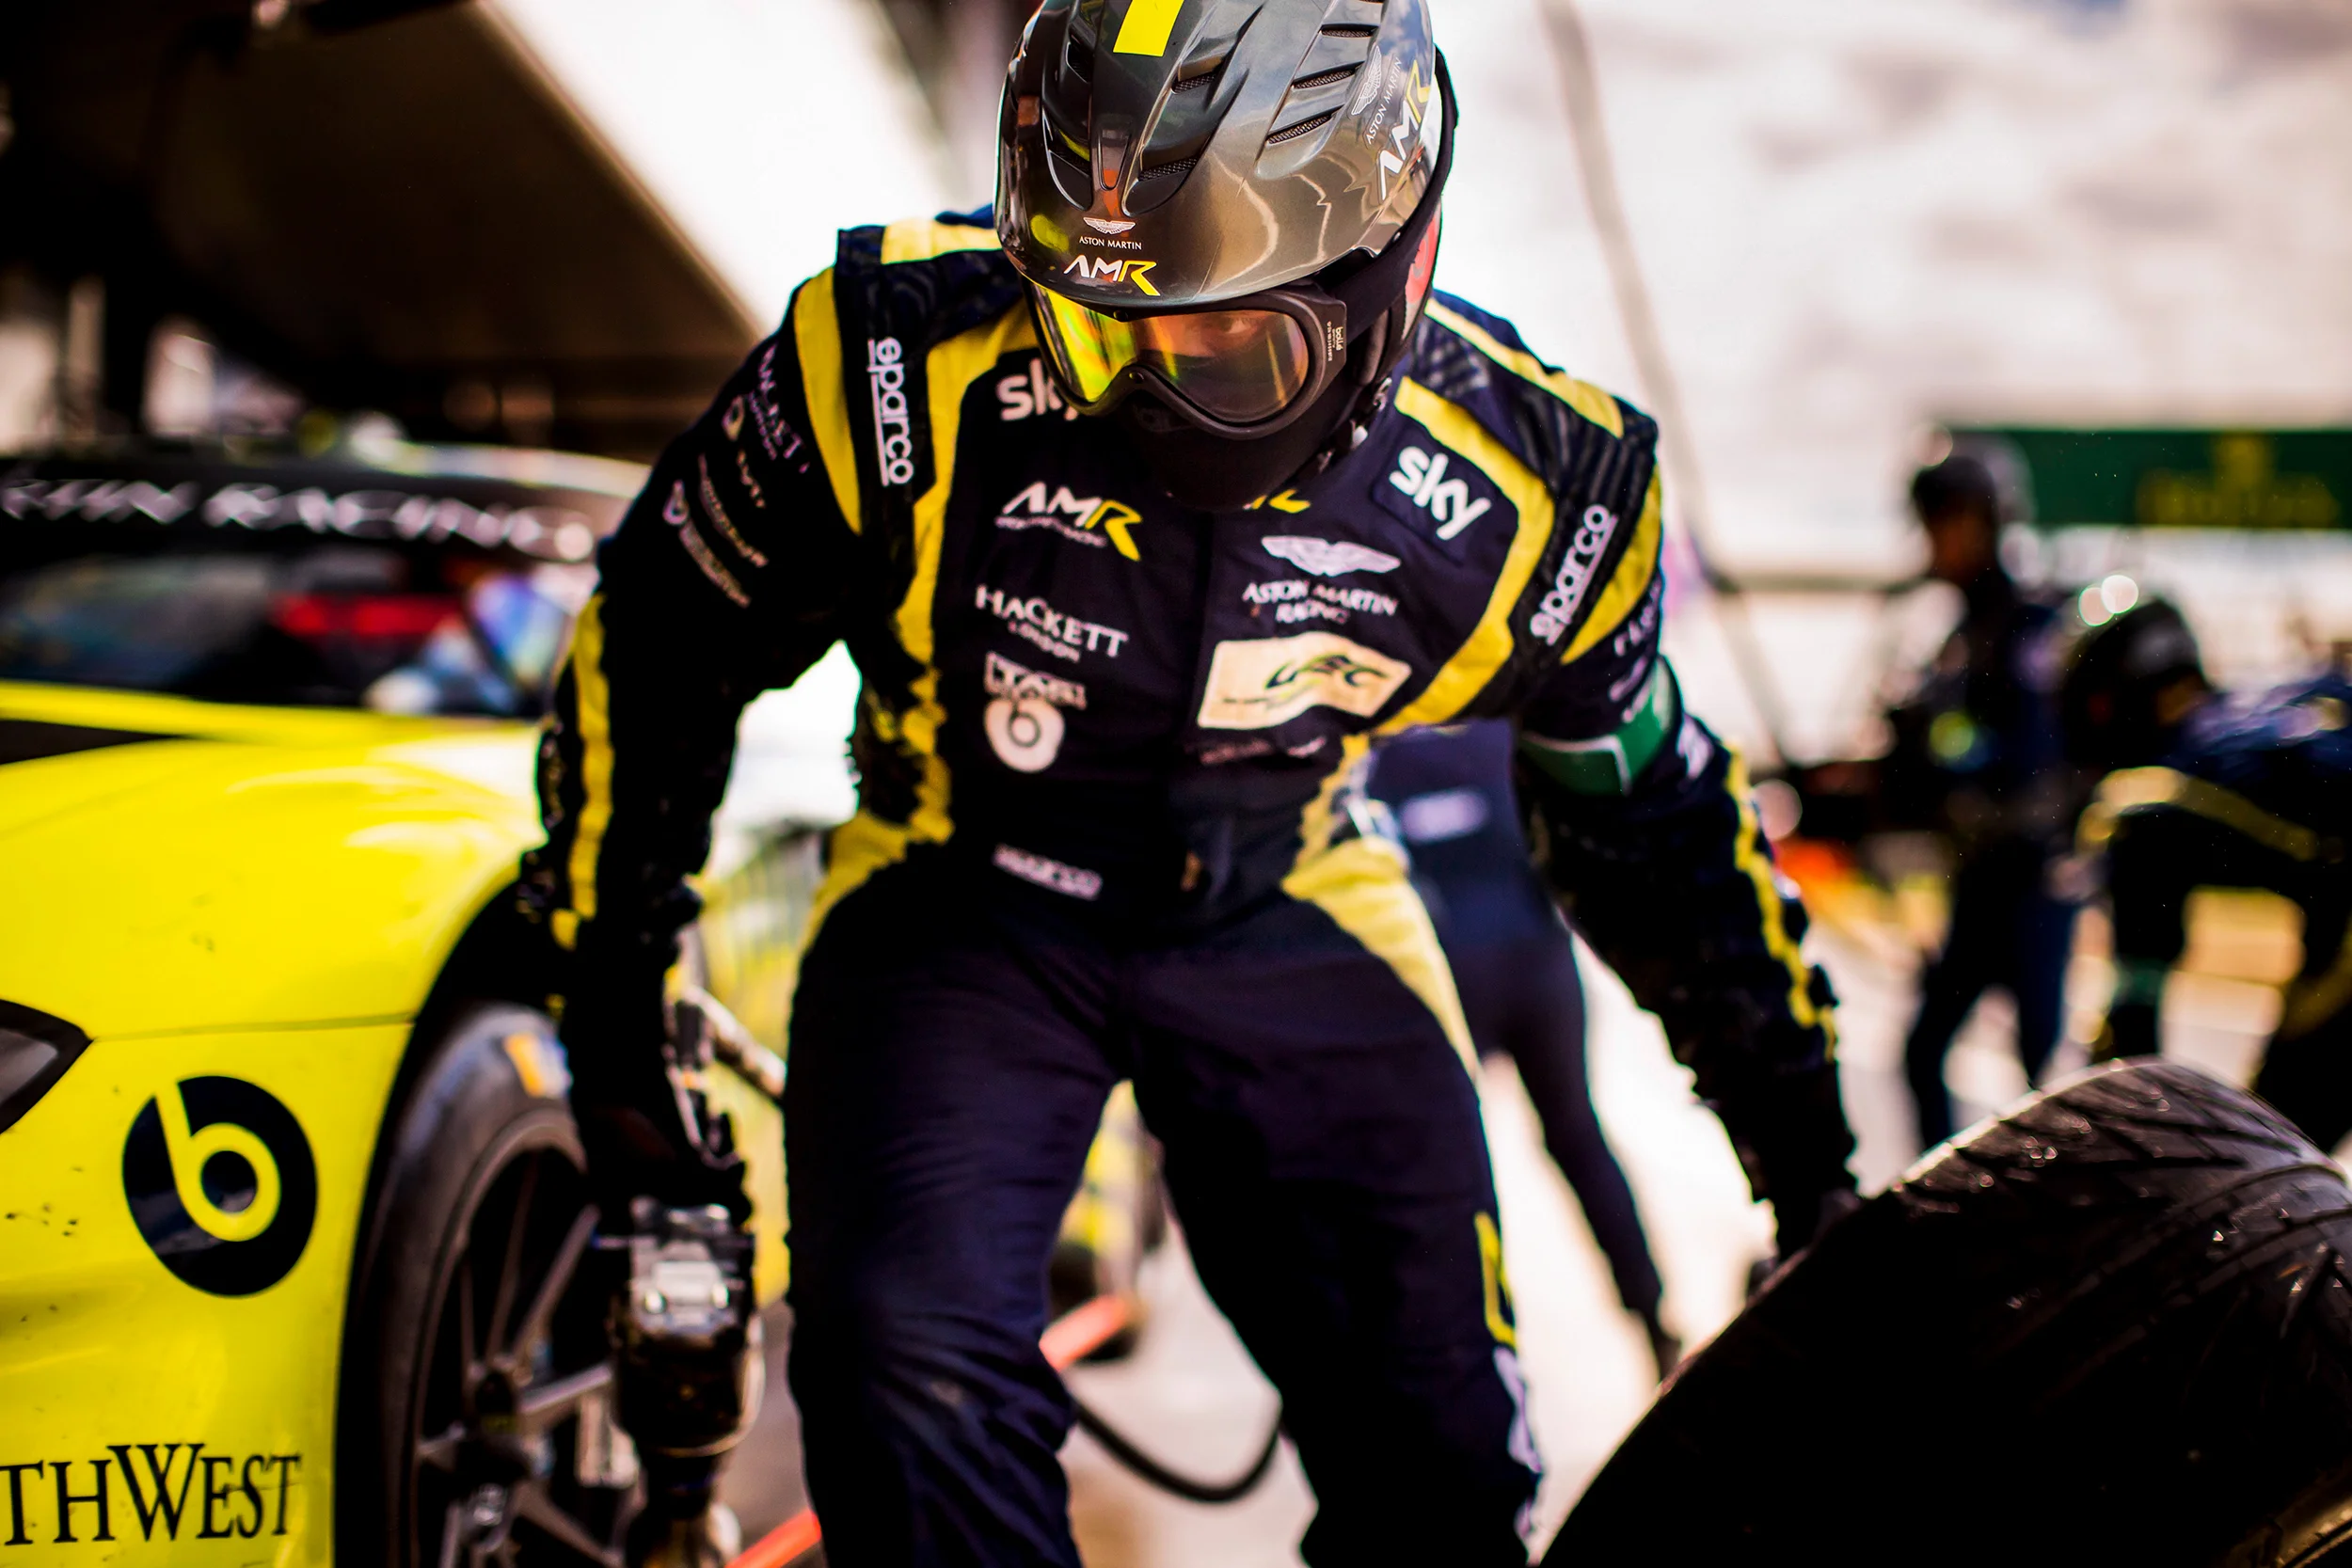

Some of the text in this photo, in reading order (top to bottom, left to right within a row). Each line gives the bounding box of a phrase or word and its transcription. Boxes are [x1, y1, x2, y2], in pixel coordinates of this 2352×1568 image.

[1366, 56, 1403, 145] ASTON MARTIN
[1380, 59, 1431, 201] AMR
[1063, 254, 1161, 296] AMR
[1078, 235, 1142, 250] ASTON MARTIN
[996, 357, 1078, 421] sk
[1002, 481, 1143, 562] AMR
[1389, 446, 1491, 541] sky
[975, 583, 1129, 657] HACKETT
[1242, 579, 1399, 616] ASTON MARTIN
